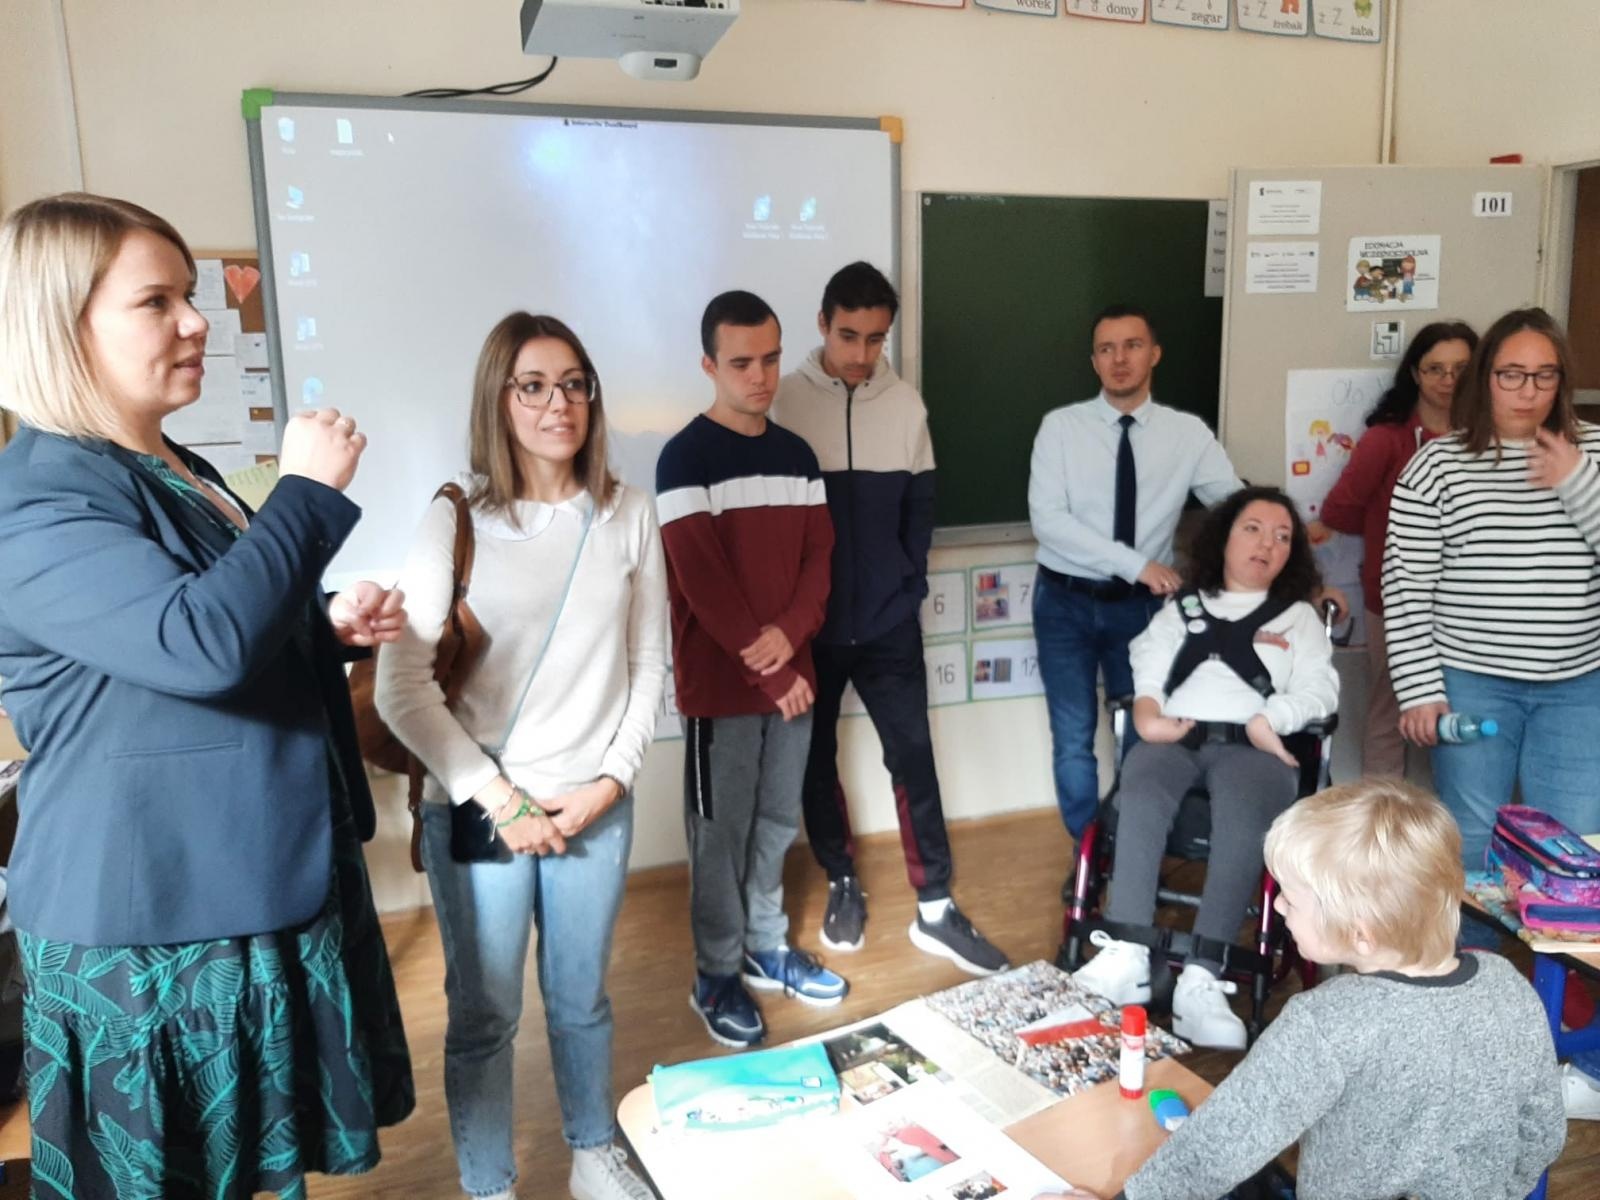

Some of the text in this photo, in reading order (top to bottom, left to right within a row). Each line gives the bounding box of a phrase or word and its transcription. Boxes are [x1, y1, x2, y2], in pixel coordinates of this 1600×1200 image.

[1106, 3, 1138, 18] domy
[1191, 12, 1222, 25] zegar
[1481, 197, 1506, 213] 101
[1020, 583, 1030, 604] 7
[933, 593, 945, 616] 6
[935, 662, 955, 685] 16
